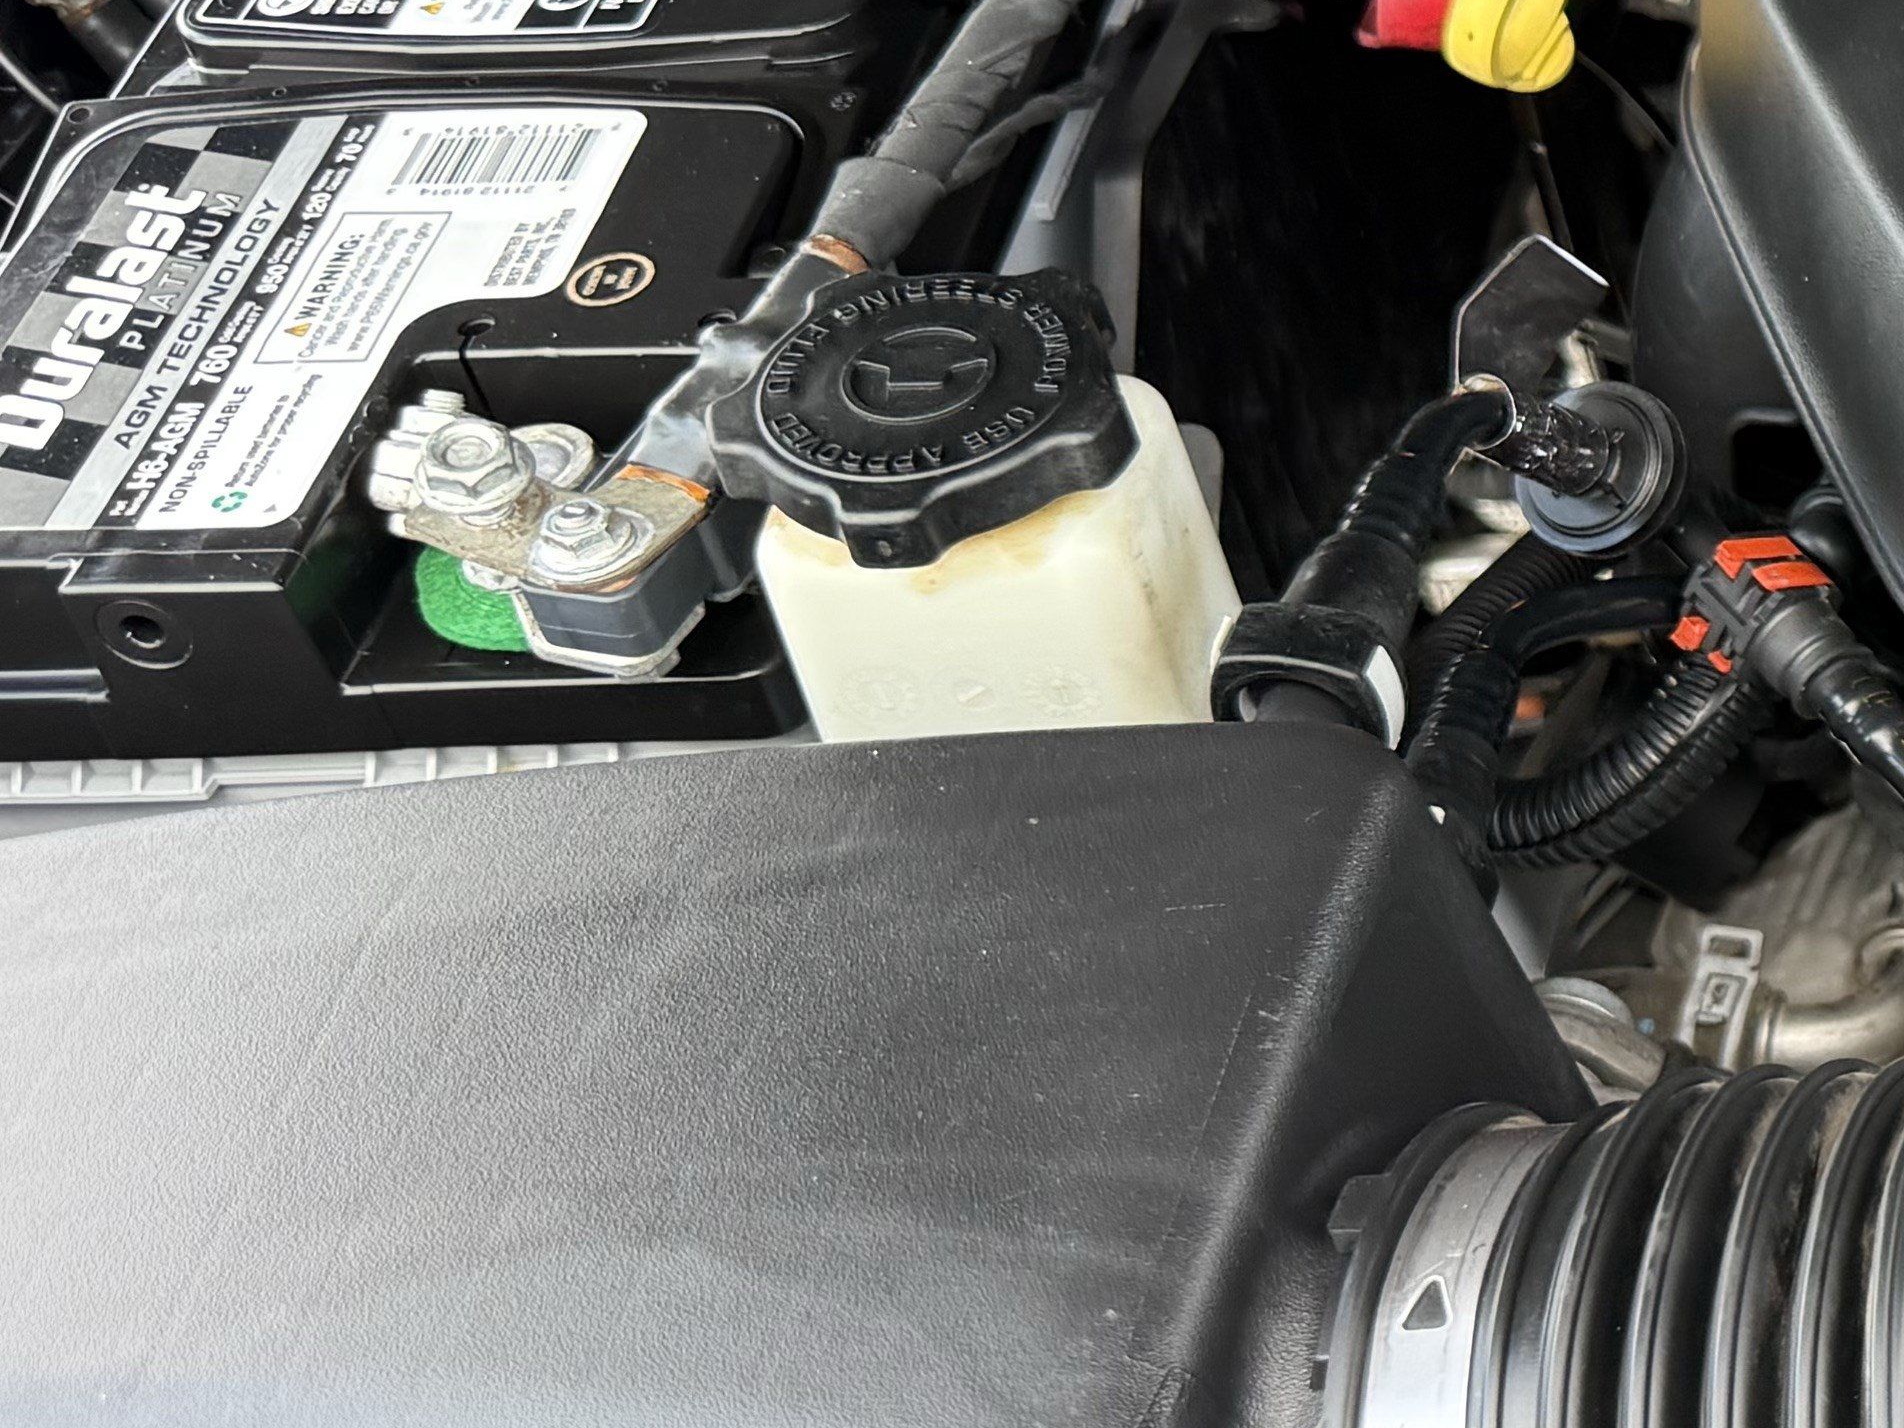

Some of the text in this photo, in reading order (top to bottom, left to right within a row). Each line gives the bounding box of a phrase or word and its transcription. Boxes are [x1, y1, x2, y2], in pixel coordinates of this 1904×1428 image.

[335, 142, 363, 163] 70
[301, 192, 332, 220] 120
[118, 192, 243, 353] PLATINUM
[255, 264, 289, 294] 950
[296, 234, 364, 320] WARNING:
[0, 182, 208, 452] Duralast
[115, 200, 278, 449] AGM TECHNOLOGY
[767, 278, 1073, 396] POWER STEERING FLUID
[189, 344, 237, 385] 760
[127, 402, 203, 489] H6-AGM
[159, 386, 252, 512] NON-SPILLABLE
[770, 405, 1036, 473] USE APPROVED
